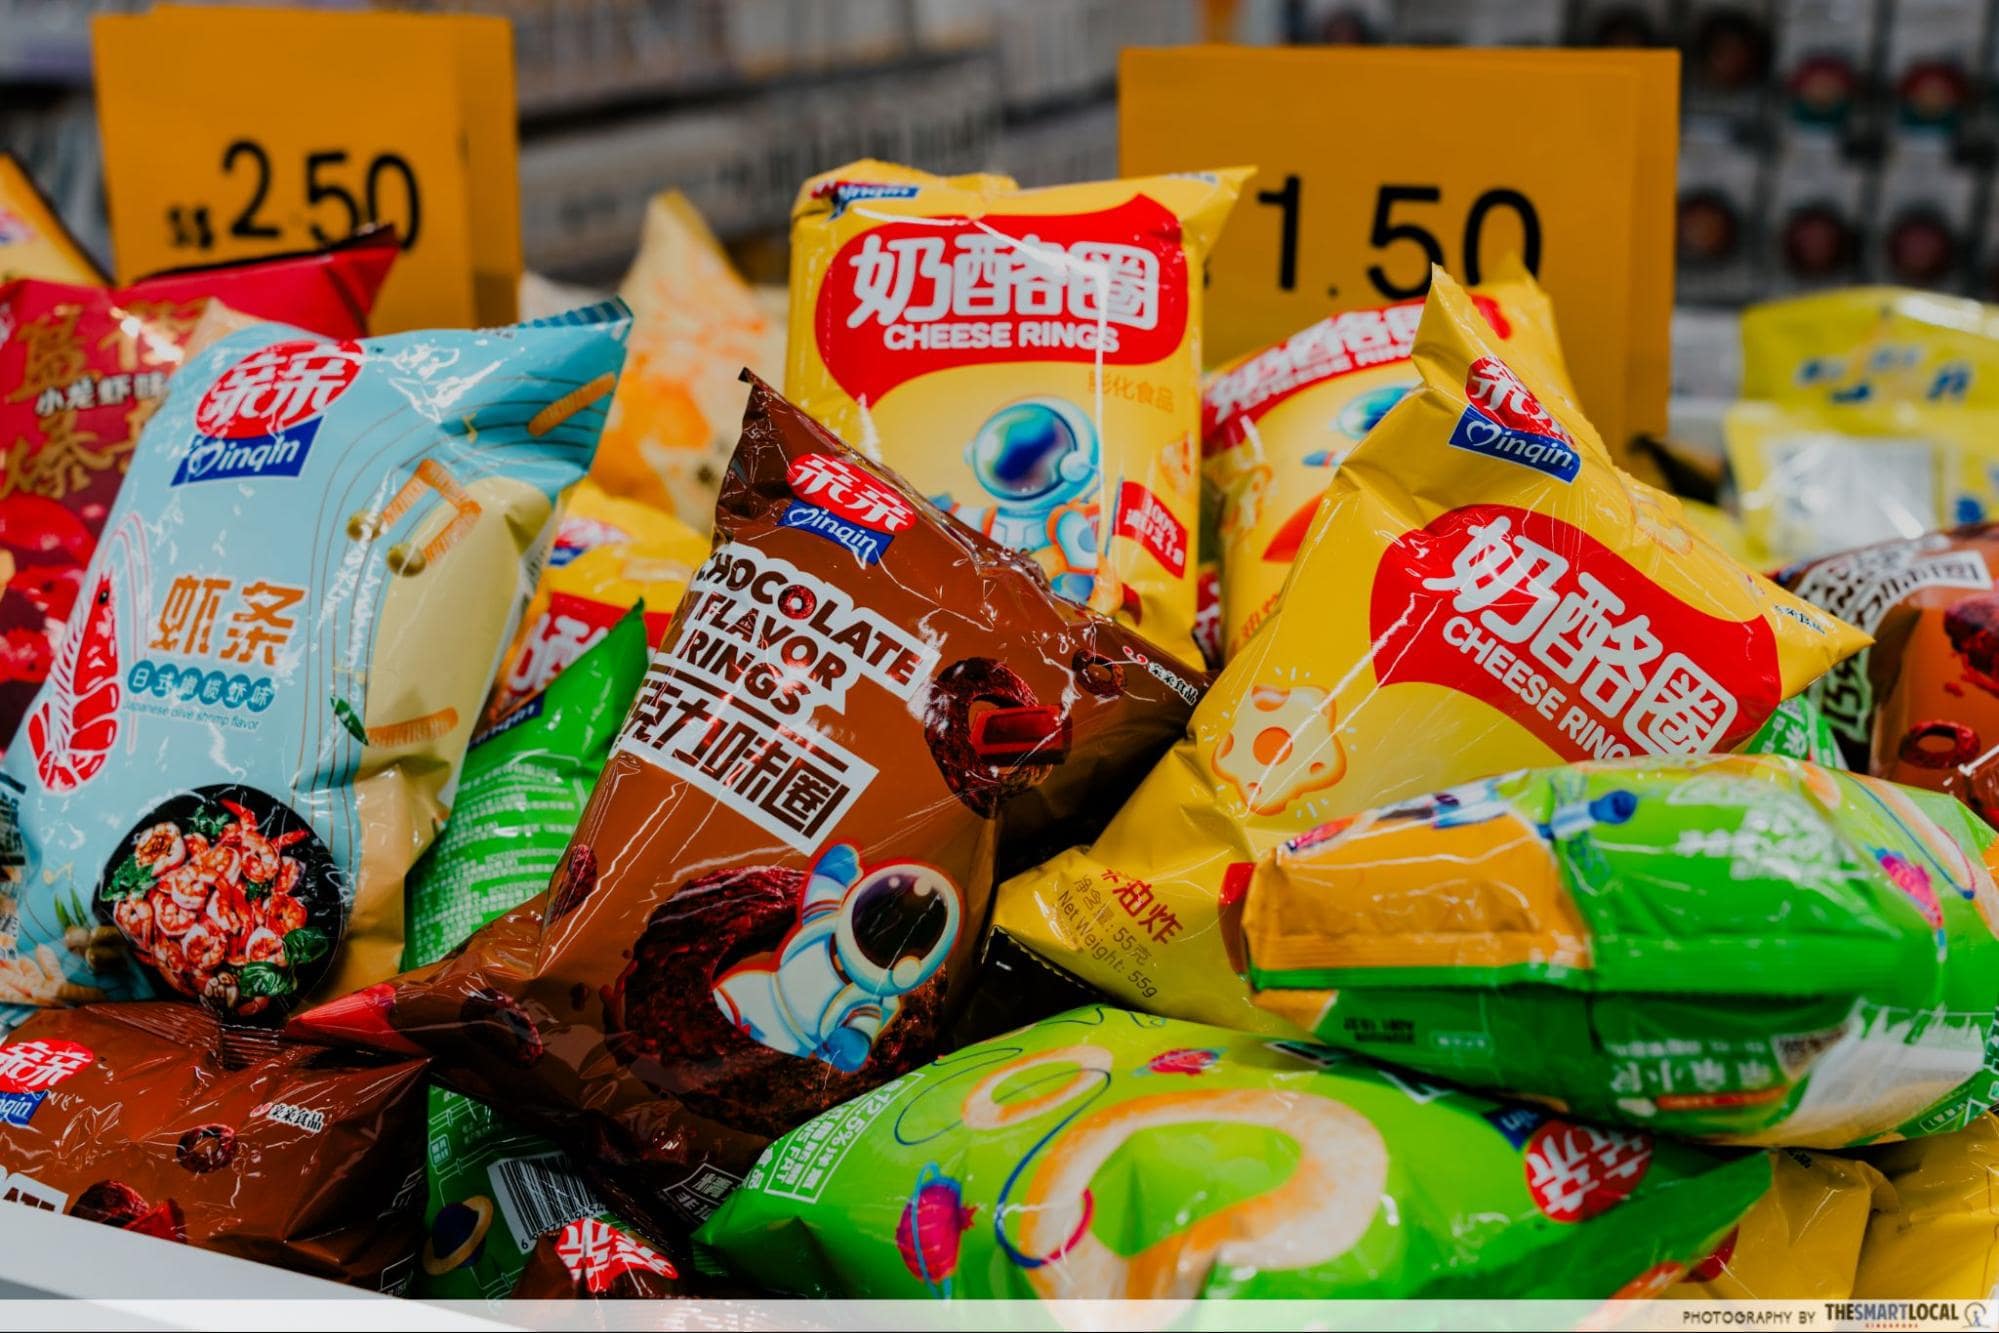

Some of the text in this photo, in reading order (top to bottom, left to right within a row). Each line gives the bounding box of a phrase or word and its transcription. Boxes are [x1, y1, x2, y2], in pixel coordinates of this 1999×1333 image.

[846, 233, 1161, 331] 奶酪圈
[1258, 174, 1542, 301] 1.50
[883, 322, 1121, 353] CHEESE RINGS
[791, 452, 914, 532] 亲亲
[148, 573, 306, 667] 虾条
[695, 590, 847, 692] FLAVOR
[697, 551, 923, 687] HOCOLATE
[1421, 515, 1739, 757] 奶酪圈
[170, 707, 194, 721] olive
[196, 711, 230, 728] shrimp
[231, 714, 260, 731] flavor
[677, 628, 811, 716] RINGS
[1442, 615, 1632, 761] CHEESE RIN
[1058, 889, 1080, 921] Net
[1127, 969, 1159, 998] 55g
